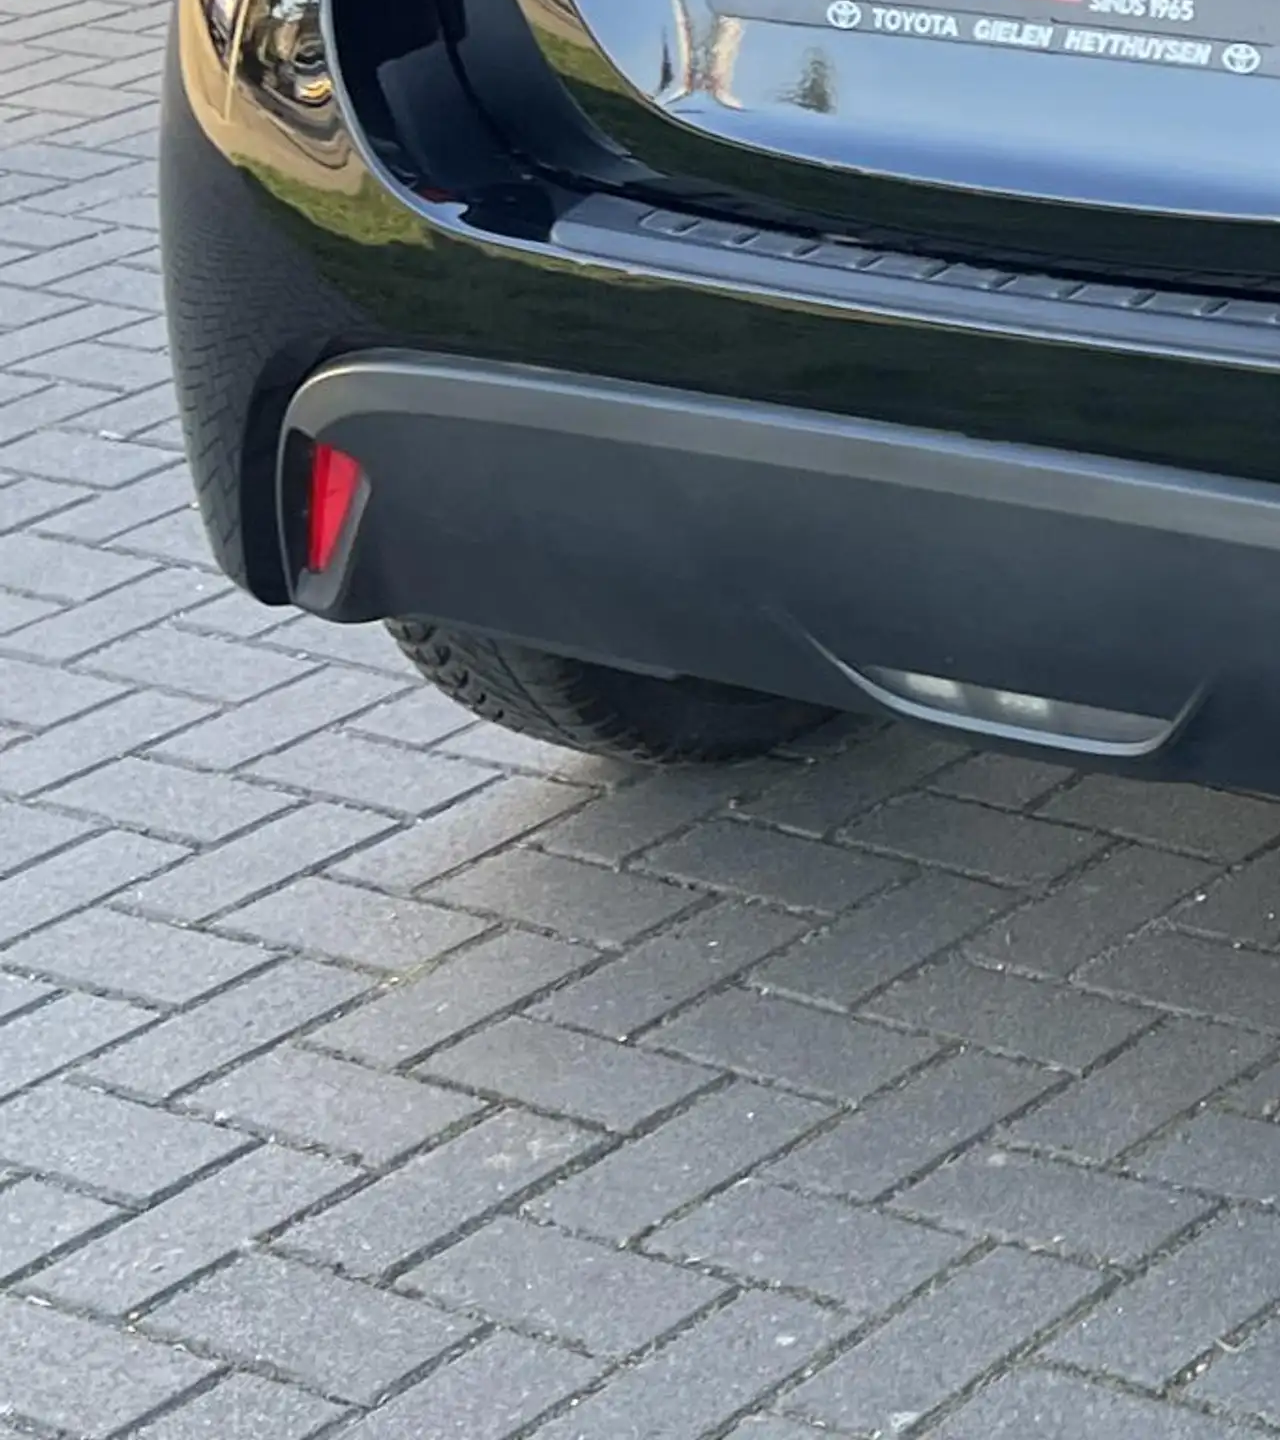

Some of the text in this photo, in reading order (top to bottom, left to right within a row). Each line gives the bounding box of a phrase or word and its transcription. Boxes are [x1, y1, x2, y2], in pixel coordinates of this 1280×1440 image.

[872, 8, 1212, 65] TOYOTA GIELEN HEYTHUYSEN
